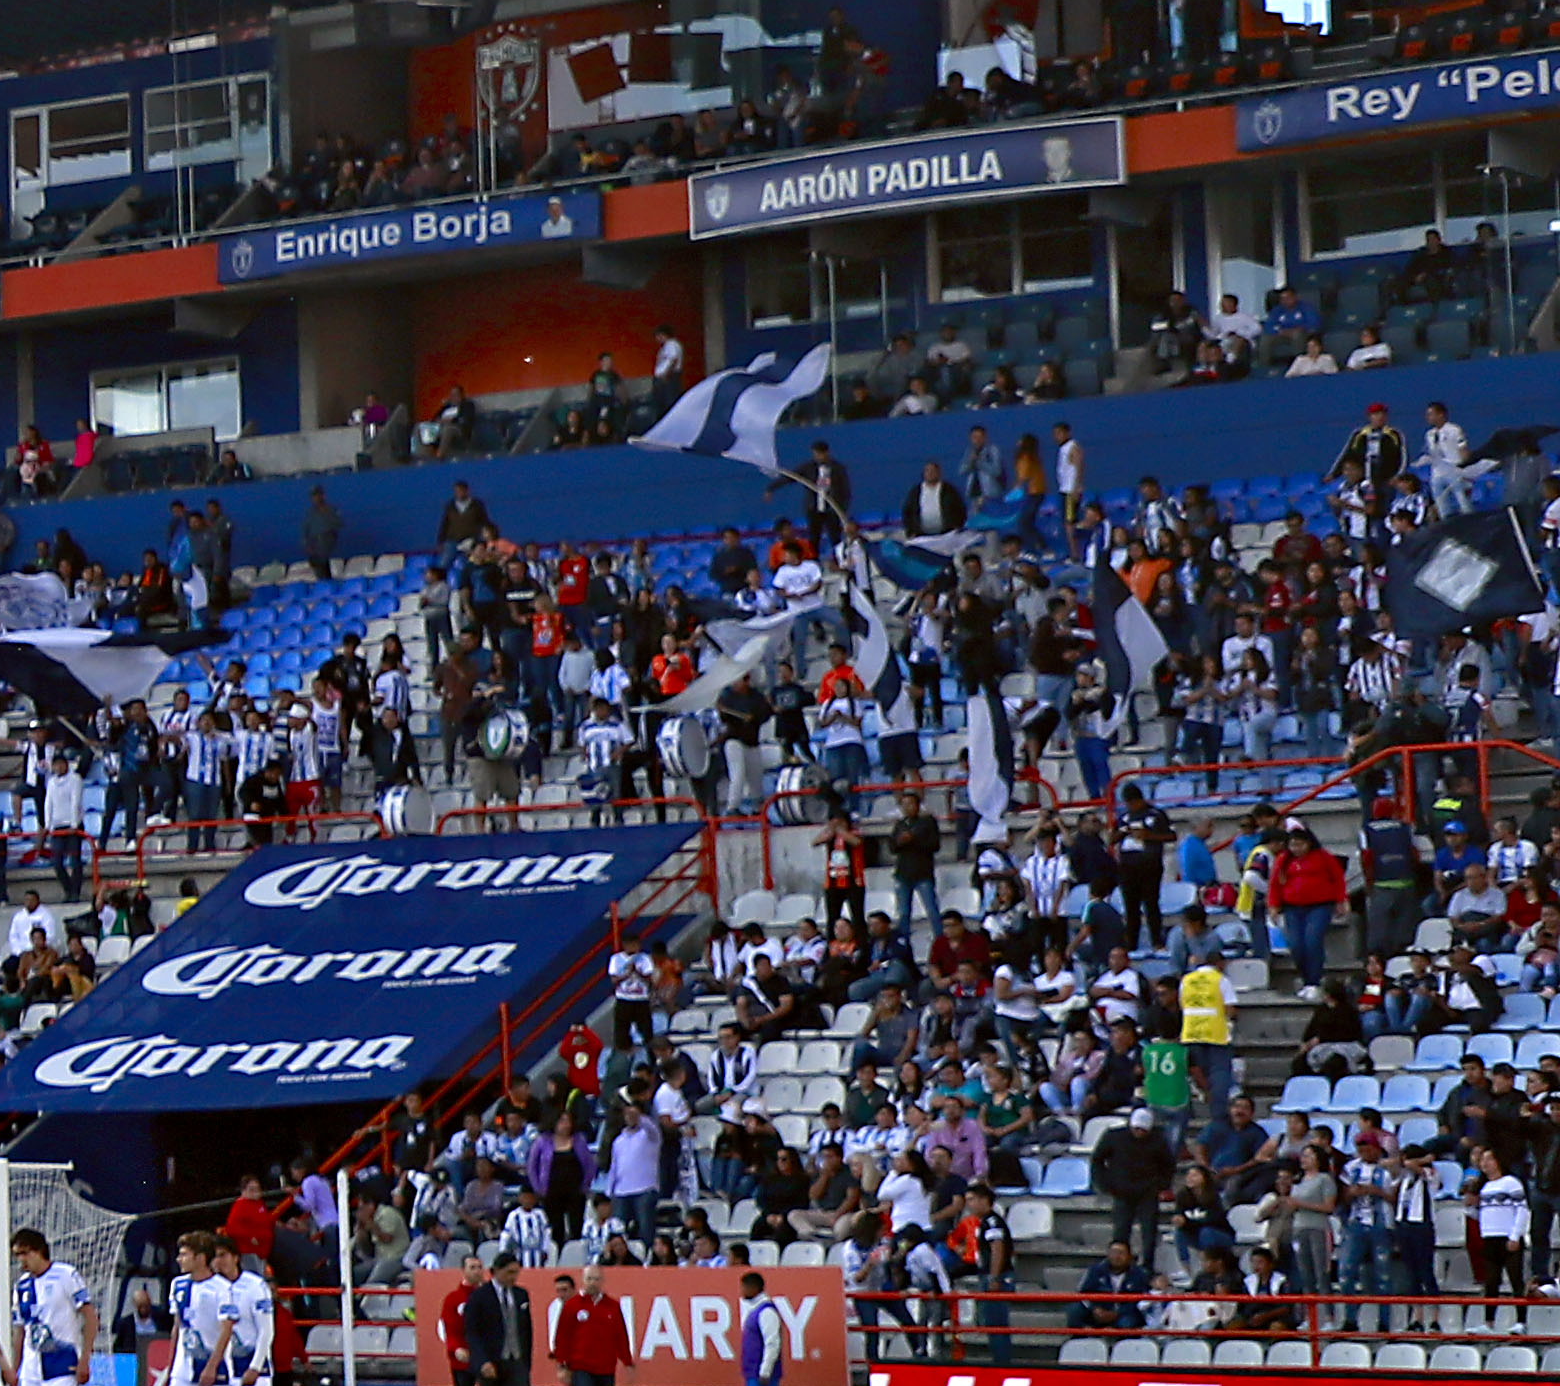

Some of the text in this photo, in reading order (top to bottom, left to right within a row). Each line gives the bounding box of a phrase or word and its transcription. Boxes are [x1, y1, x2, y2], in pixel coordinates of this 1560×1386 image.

[1325, 59, 1560, 122] Rey “Pel
[759, 149, 1003, 213] AARÓN PADILLA
[275, 206, 512, 262] Enrique Borja
[242, 850, 616, 911] Corona
[140, 940, 519, 1000] Corona
[33, 1033, 416, 1094] Corona
[1149, 1050, 1177, 1076] 16
